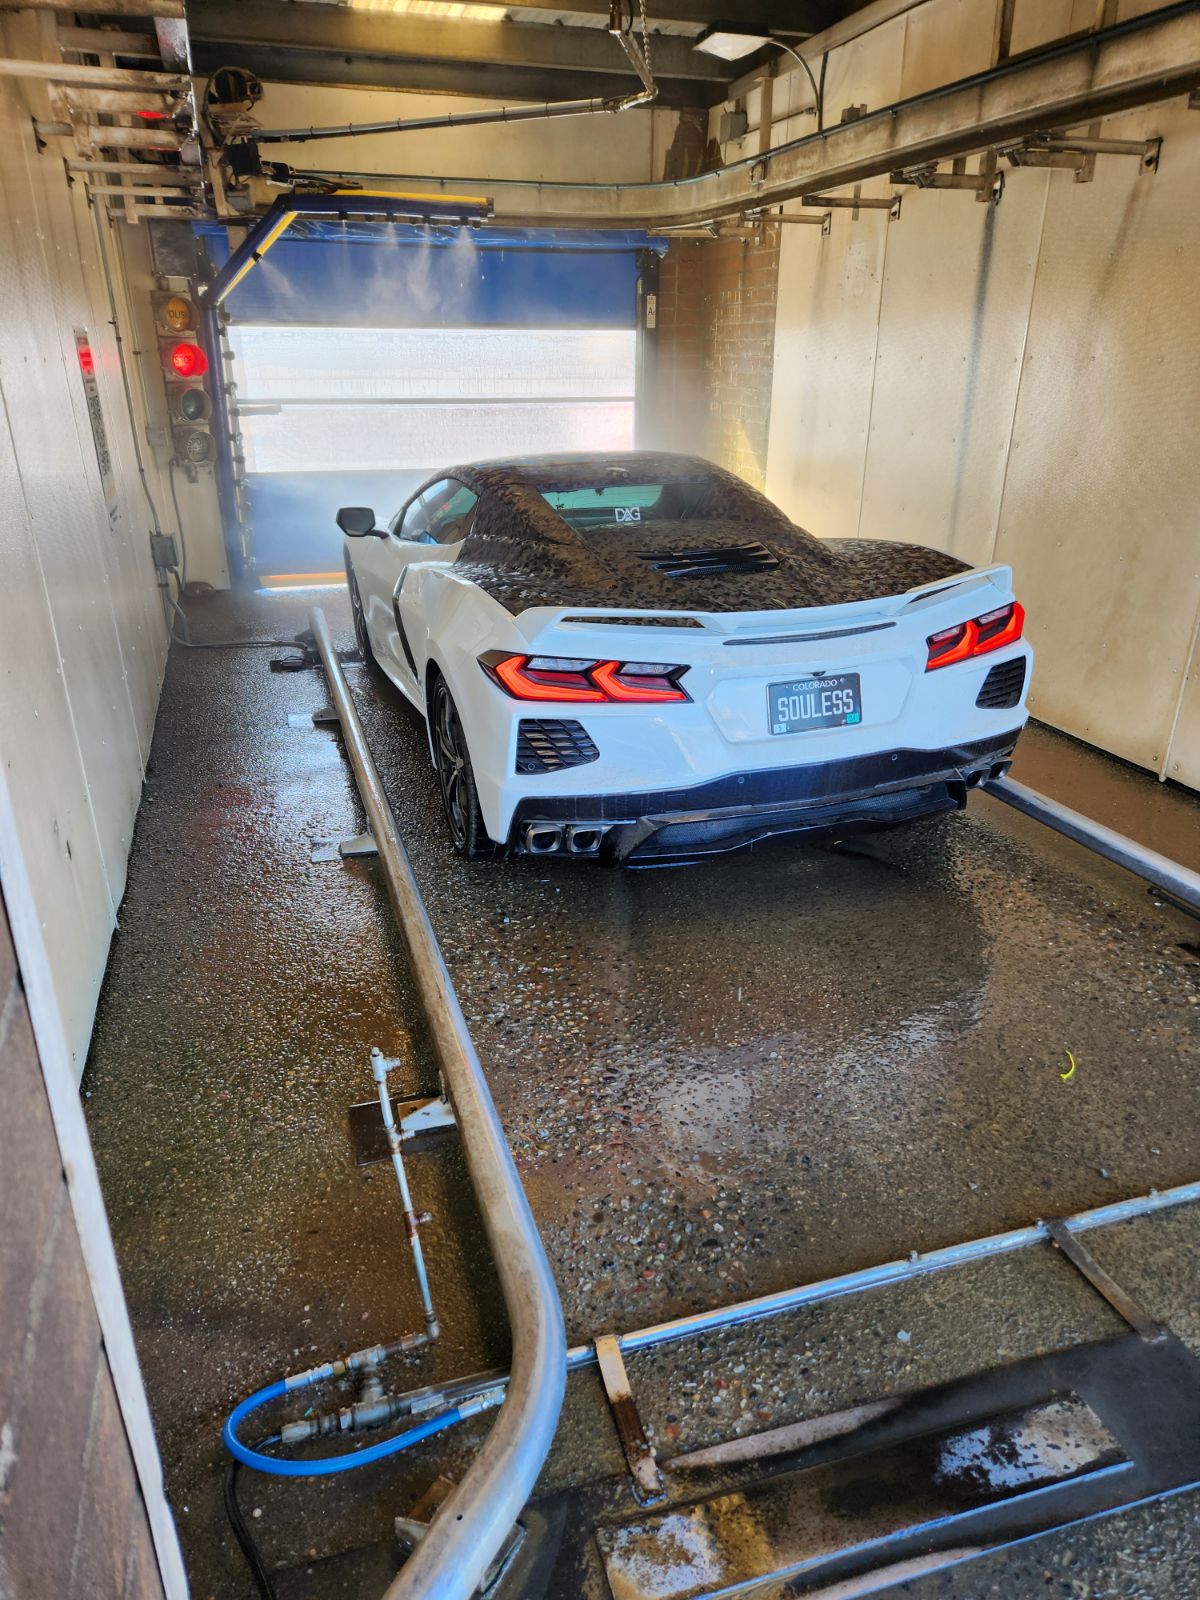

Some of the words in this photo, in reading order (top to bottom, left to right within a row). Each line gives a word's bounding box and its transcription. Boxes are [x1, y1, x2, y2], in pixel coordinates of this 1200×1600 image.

[174, 355, 193, 365] STOP
[792, 679, 838, 691] COLORADO
[777, 689, 854, 722] SOULESS
